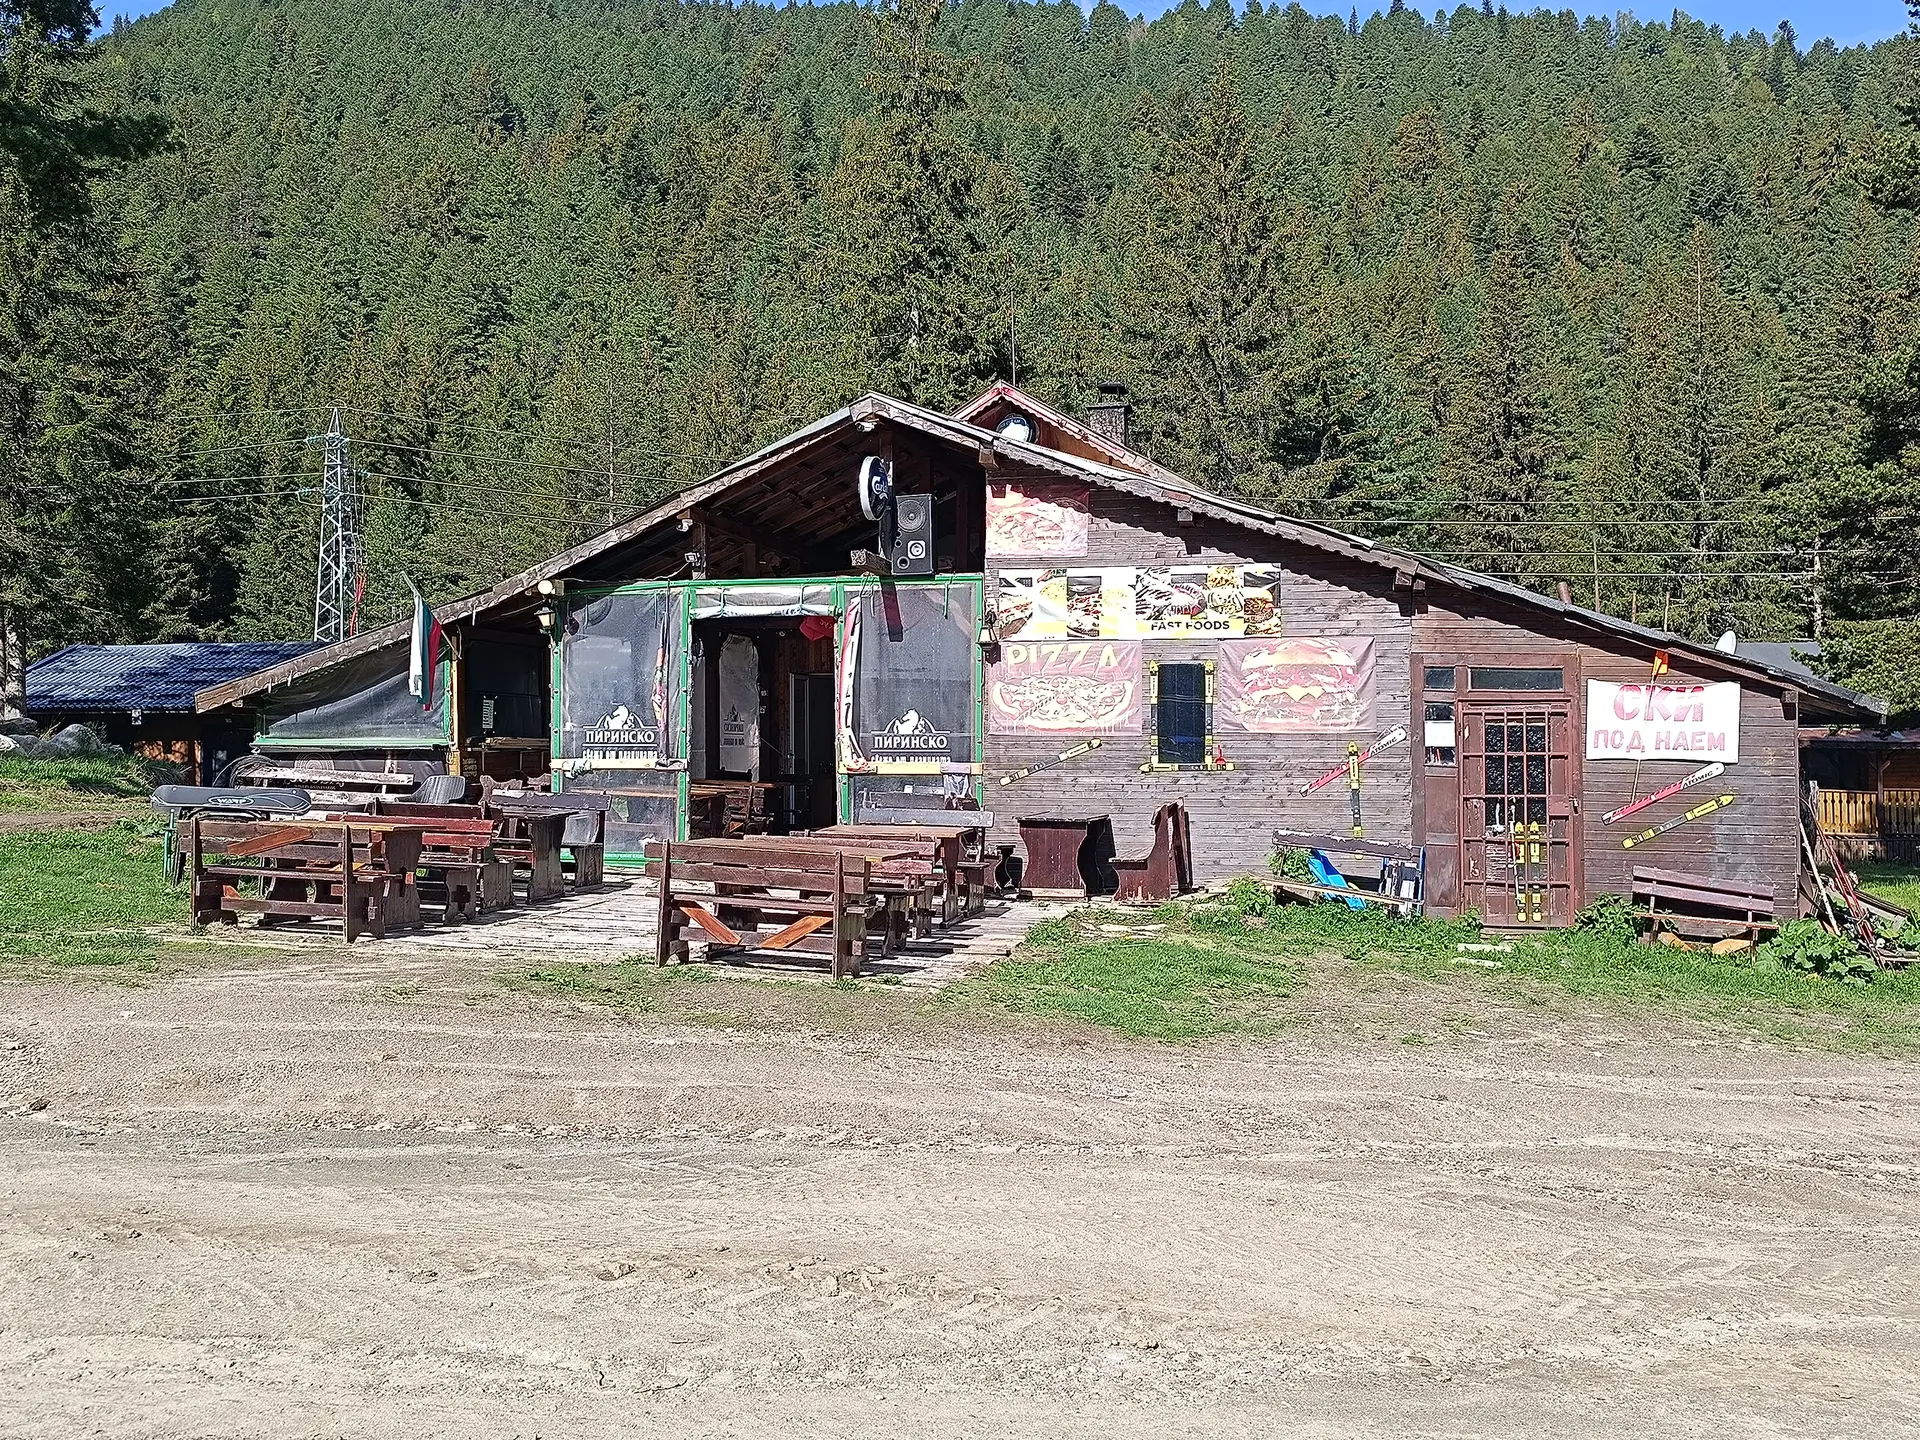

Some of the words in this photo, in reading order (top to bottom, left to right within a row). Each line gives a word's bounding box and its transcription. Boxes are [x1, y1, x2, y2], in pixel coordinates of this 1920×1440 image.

[1151, 621, 1182, 630] FAST
[1186, 621, 1230, 630] FOODS
[1006, 643, 1124, 678] PIZZA
[1613, 684, 1705, 722] СКИ
[585, 730, 655, 743] ПИРИНСКО
[874, 736, 948, 749] ПИРИНСКО
[1370, 736, 1398, 757] ATOMIC
[1593, 729, 1645, 753] ПОД
[1655, 730, 1726, 752] НАЕМ
[1682, 770, 1714, 789] ATOMIC
